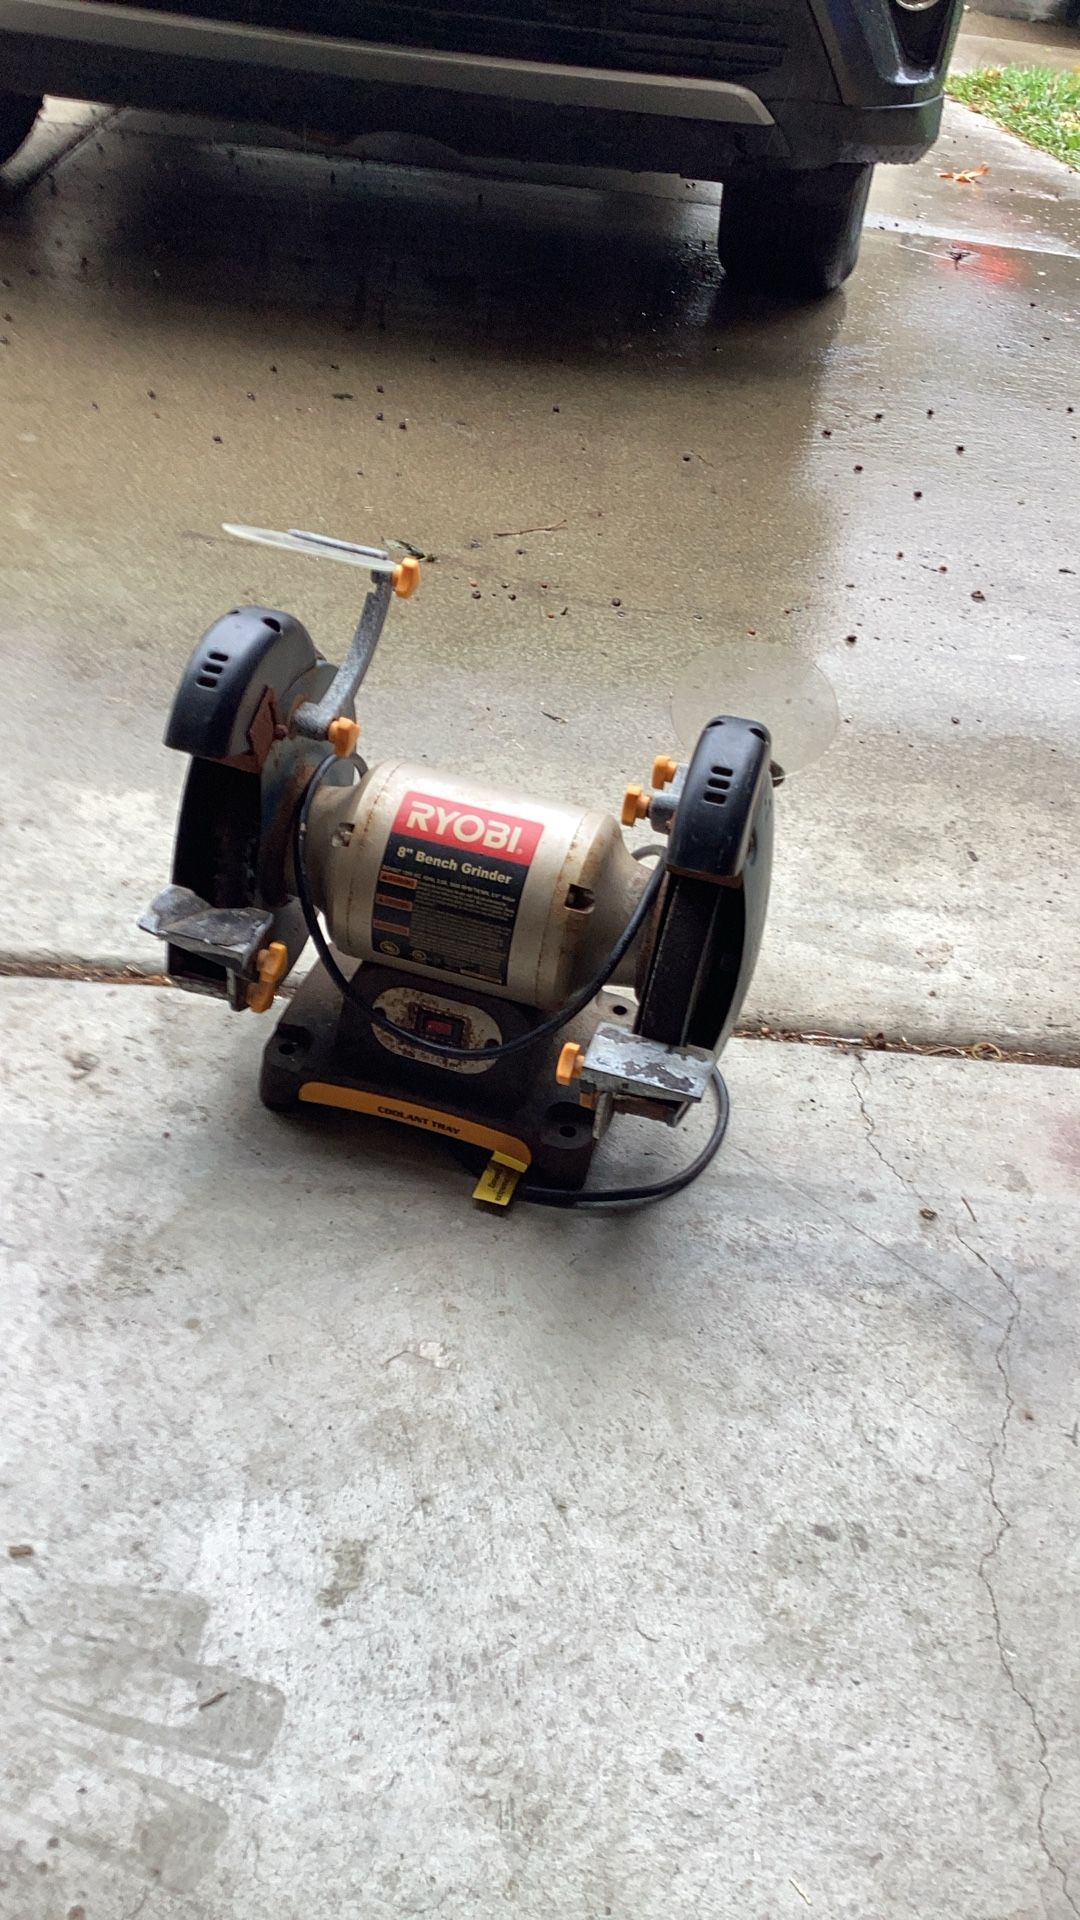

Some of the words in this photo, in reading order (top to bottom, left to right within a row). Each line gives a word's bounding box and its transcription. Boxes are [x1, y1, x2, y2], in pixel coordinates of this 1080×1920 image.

[406, 801, 523, 853] RYOBI
[397, 846, 413, 858] 8"
[415, 850, 458, 871] Bench
[461, 863, 513, 885] Grinder
[377, 1106, 429, 1125] COOLANT
[431, 1121, 461, 1134] TRAY
